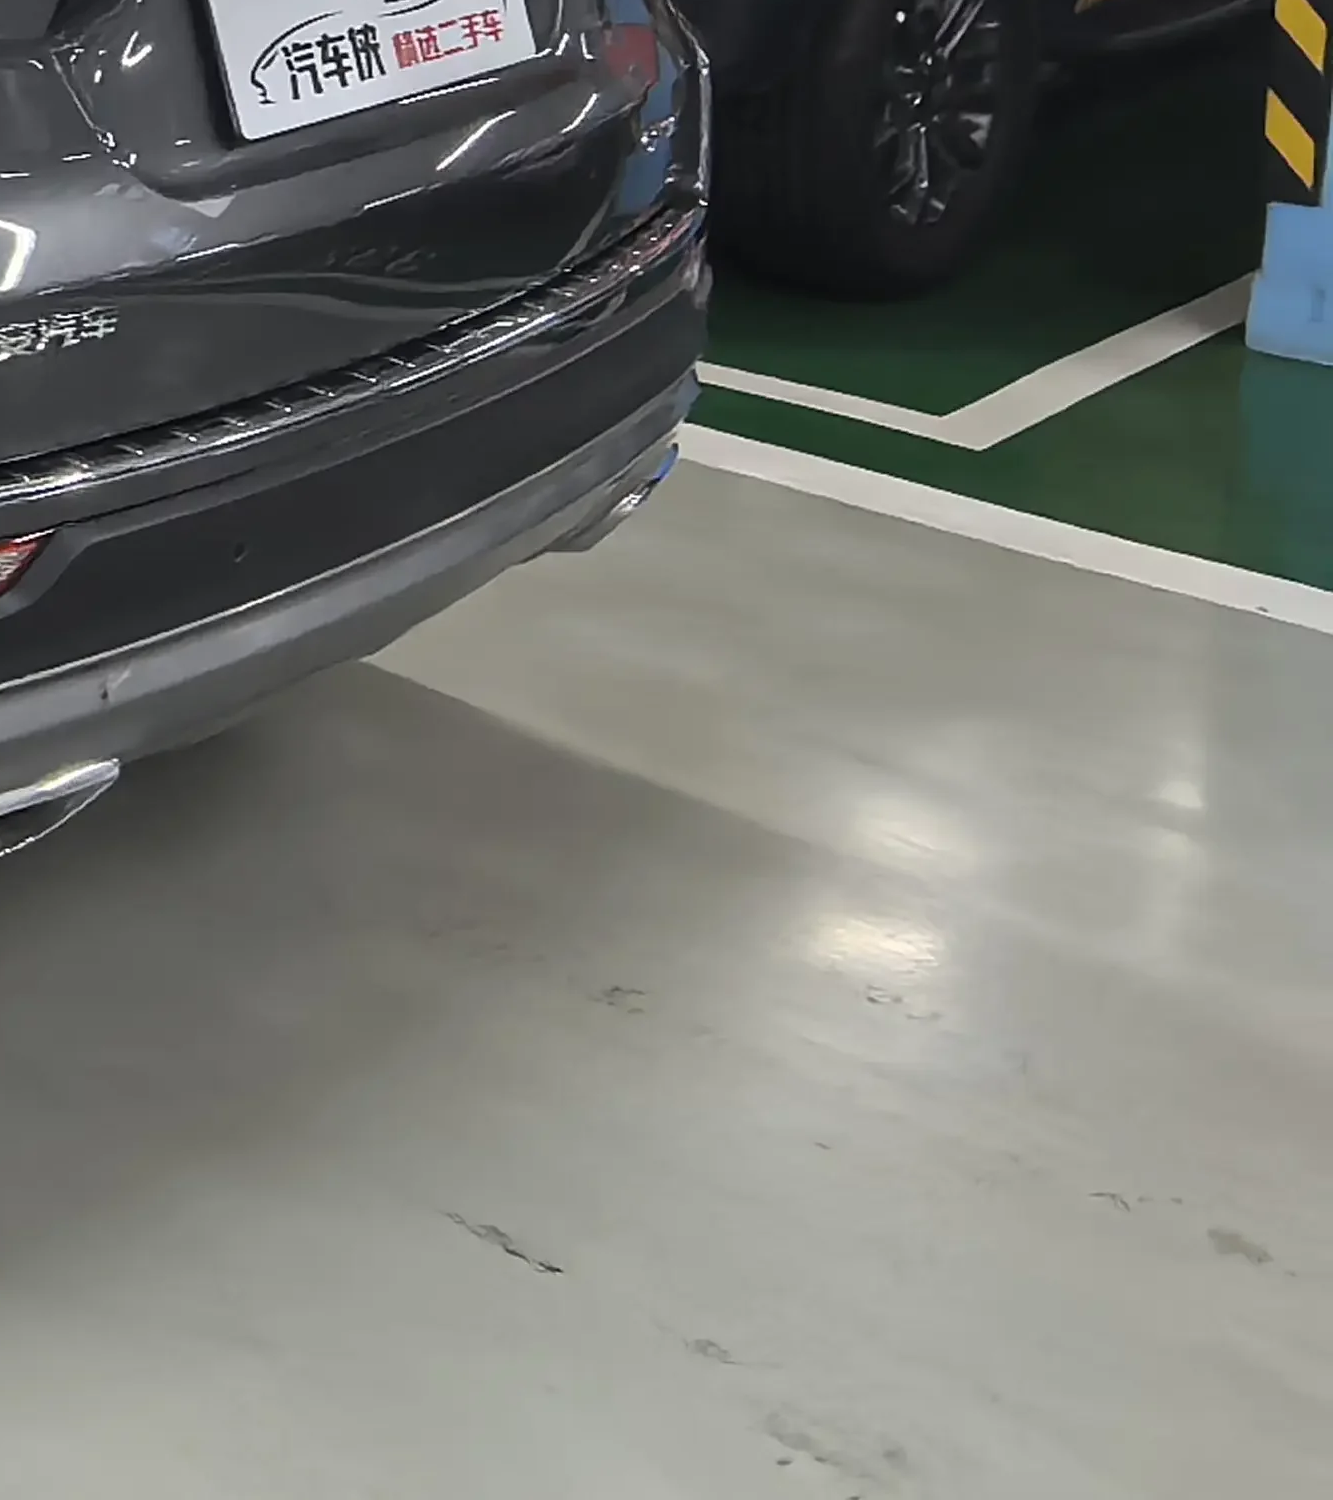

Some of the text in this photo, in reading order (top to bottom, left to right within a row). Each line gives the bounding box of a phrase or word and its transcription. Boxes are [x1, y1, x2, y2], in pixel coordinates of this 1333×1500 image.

[280, 23, 387, 100] 汽车侠
[392, 9, 505, 69] 精选二手车
